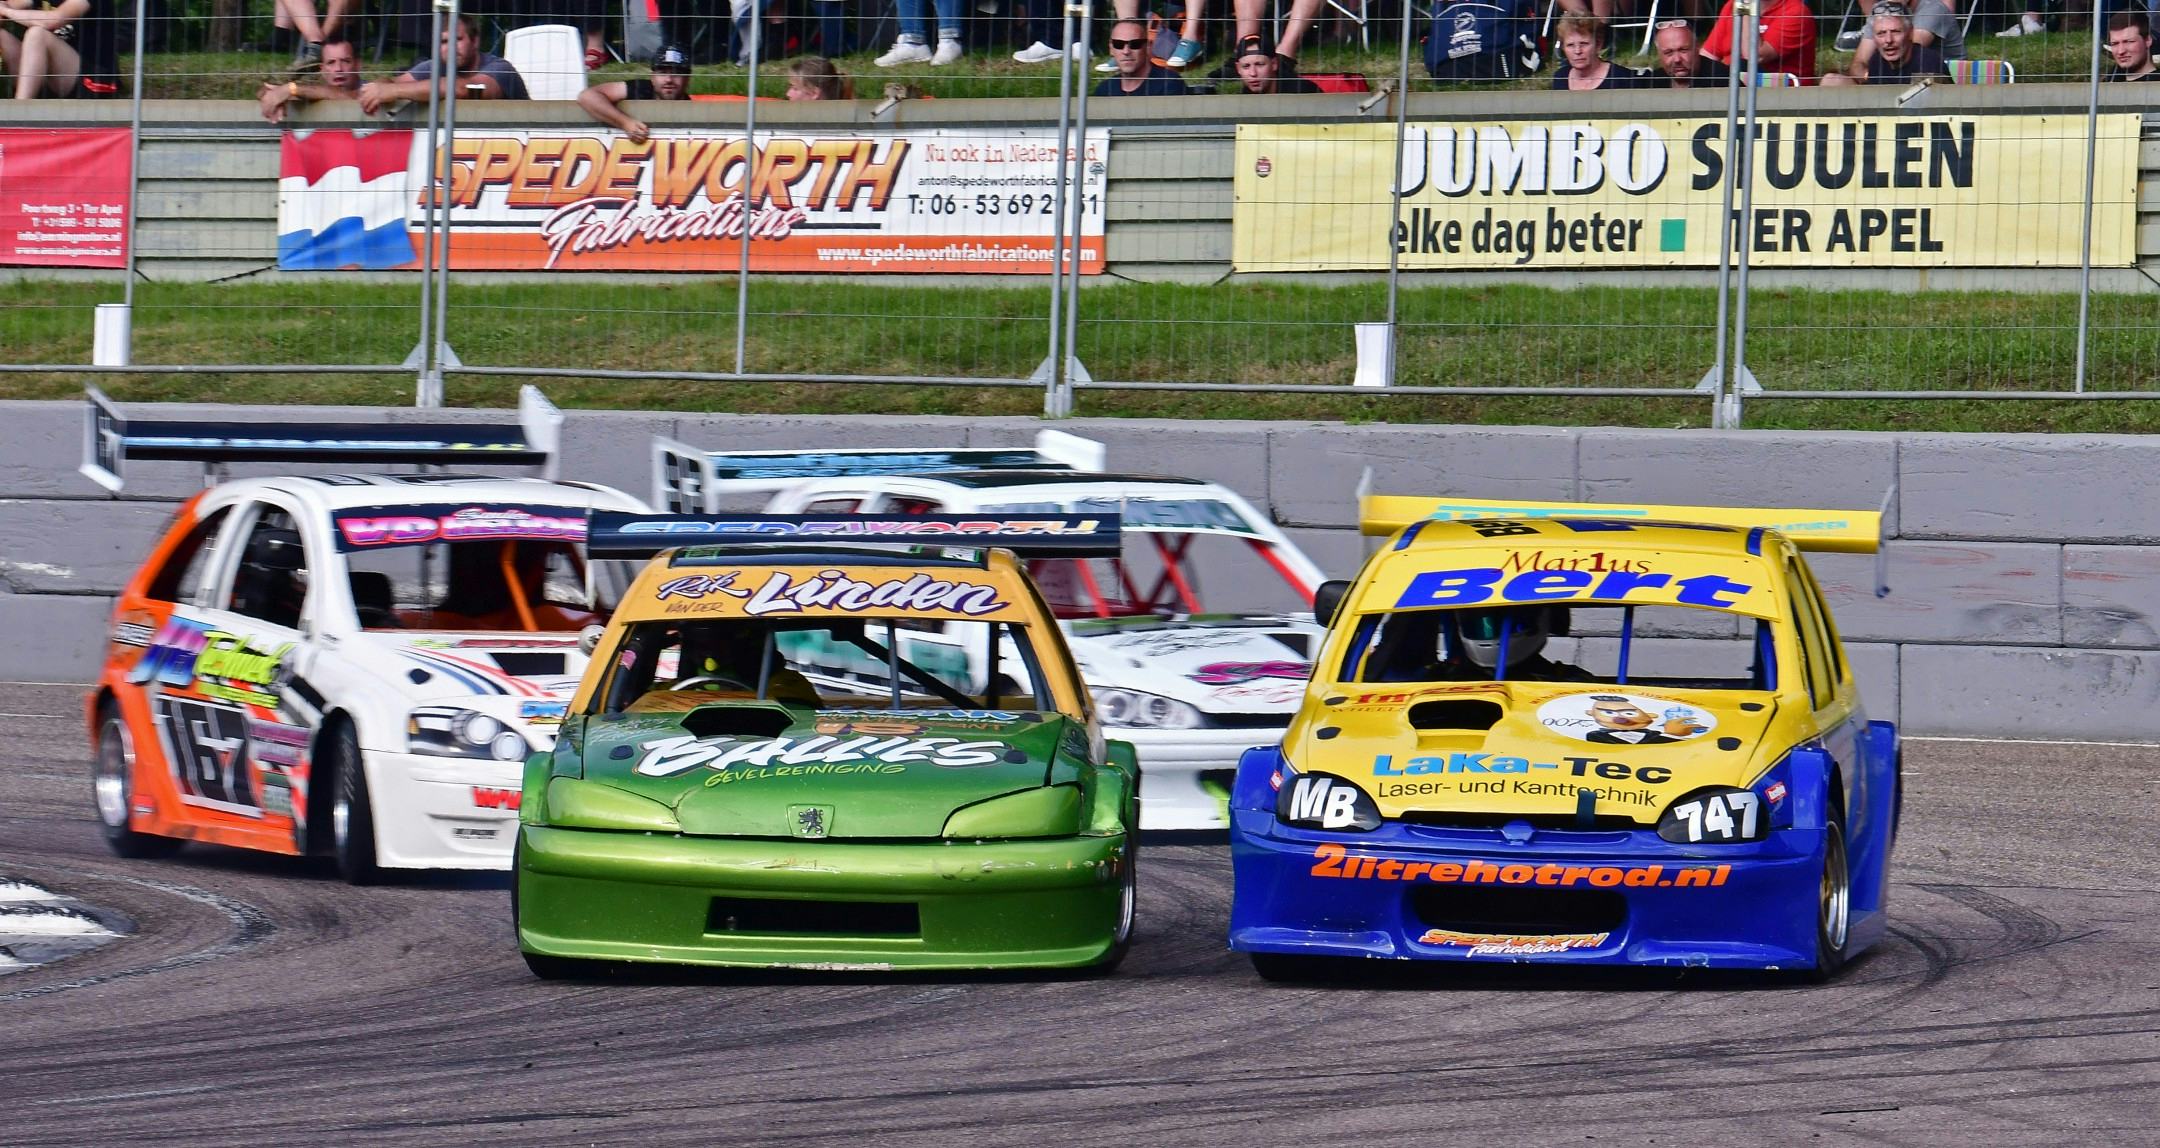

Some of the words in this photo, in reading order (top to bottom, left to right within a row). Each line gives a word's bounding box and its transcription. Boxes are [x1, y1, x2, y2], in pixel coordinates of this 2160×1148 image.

[417, 137, 911, 212] SPEDEWORTH
[925, 144, 945, 162] Nu
[950, 143, 980, 162] ook
[983, 144, 1005, 162] in
[1390, 124, 1669, 197] JUMBO
[1692, 122, 1975, 190] STUULEN
[908, 194, 923, 214] T:
[931, 194, 956, 214] 06
[976, 194, 1000, 214] 53
[1008, 194, 1033, 214] 69
[541, 197, 807, 269] Fabrications
[1389, 207, 1463, 253] elke
[1472, 207, 1536, 264] dag
[1546, 206, 1643, 253] beter
[1826, 208, 1944, 252] APEL
[656, 570, 752, 600] Rik
[743, 569, 1014, 617] Linden
[664, 601, 694, 614] VAN
[693, 601, 725, 613] DER
[1393, 568, 1753, 610] Bert
[704, 763, 905, 788] GEVELREINIGING
[1373, 752, 1673, 785] LaKa-Tec
[1378, 779, 1452, 798] Laser-
[1459, 780, 1506, 795] und
[1290, 777, 1357, 829] MB
[1674, 791, 1759, 842] 747
[1310, 843, 1731, 887] 2litrehotrod.nl
[1418, 928, 1610, 948] SPEDEWORTH
